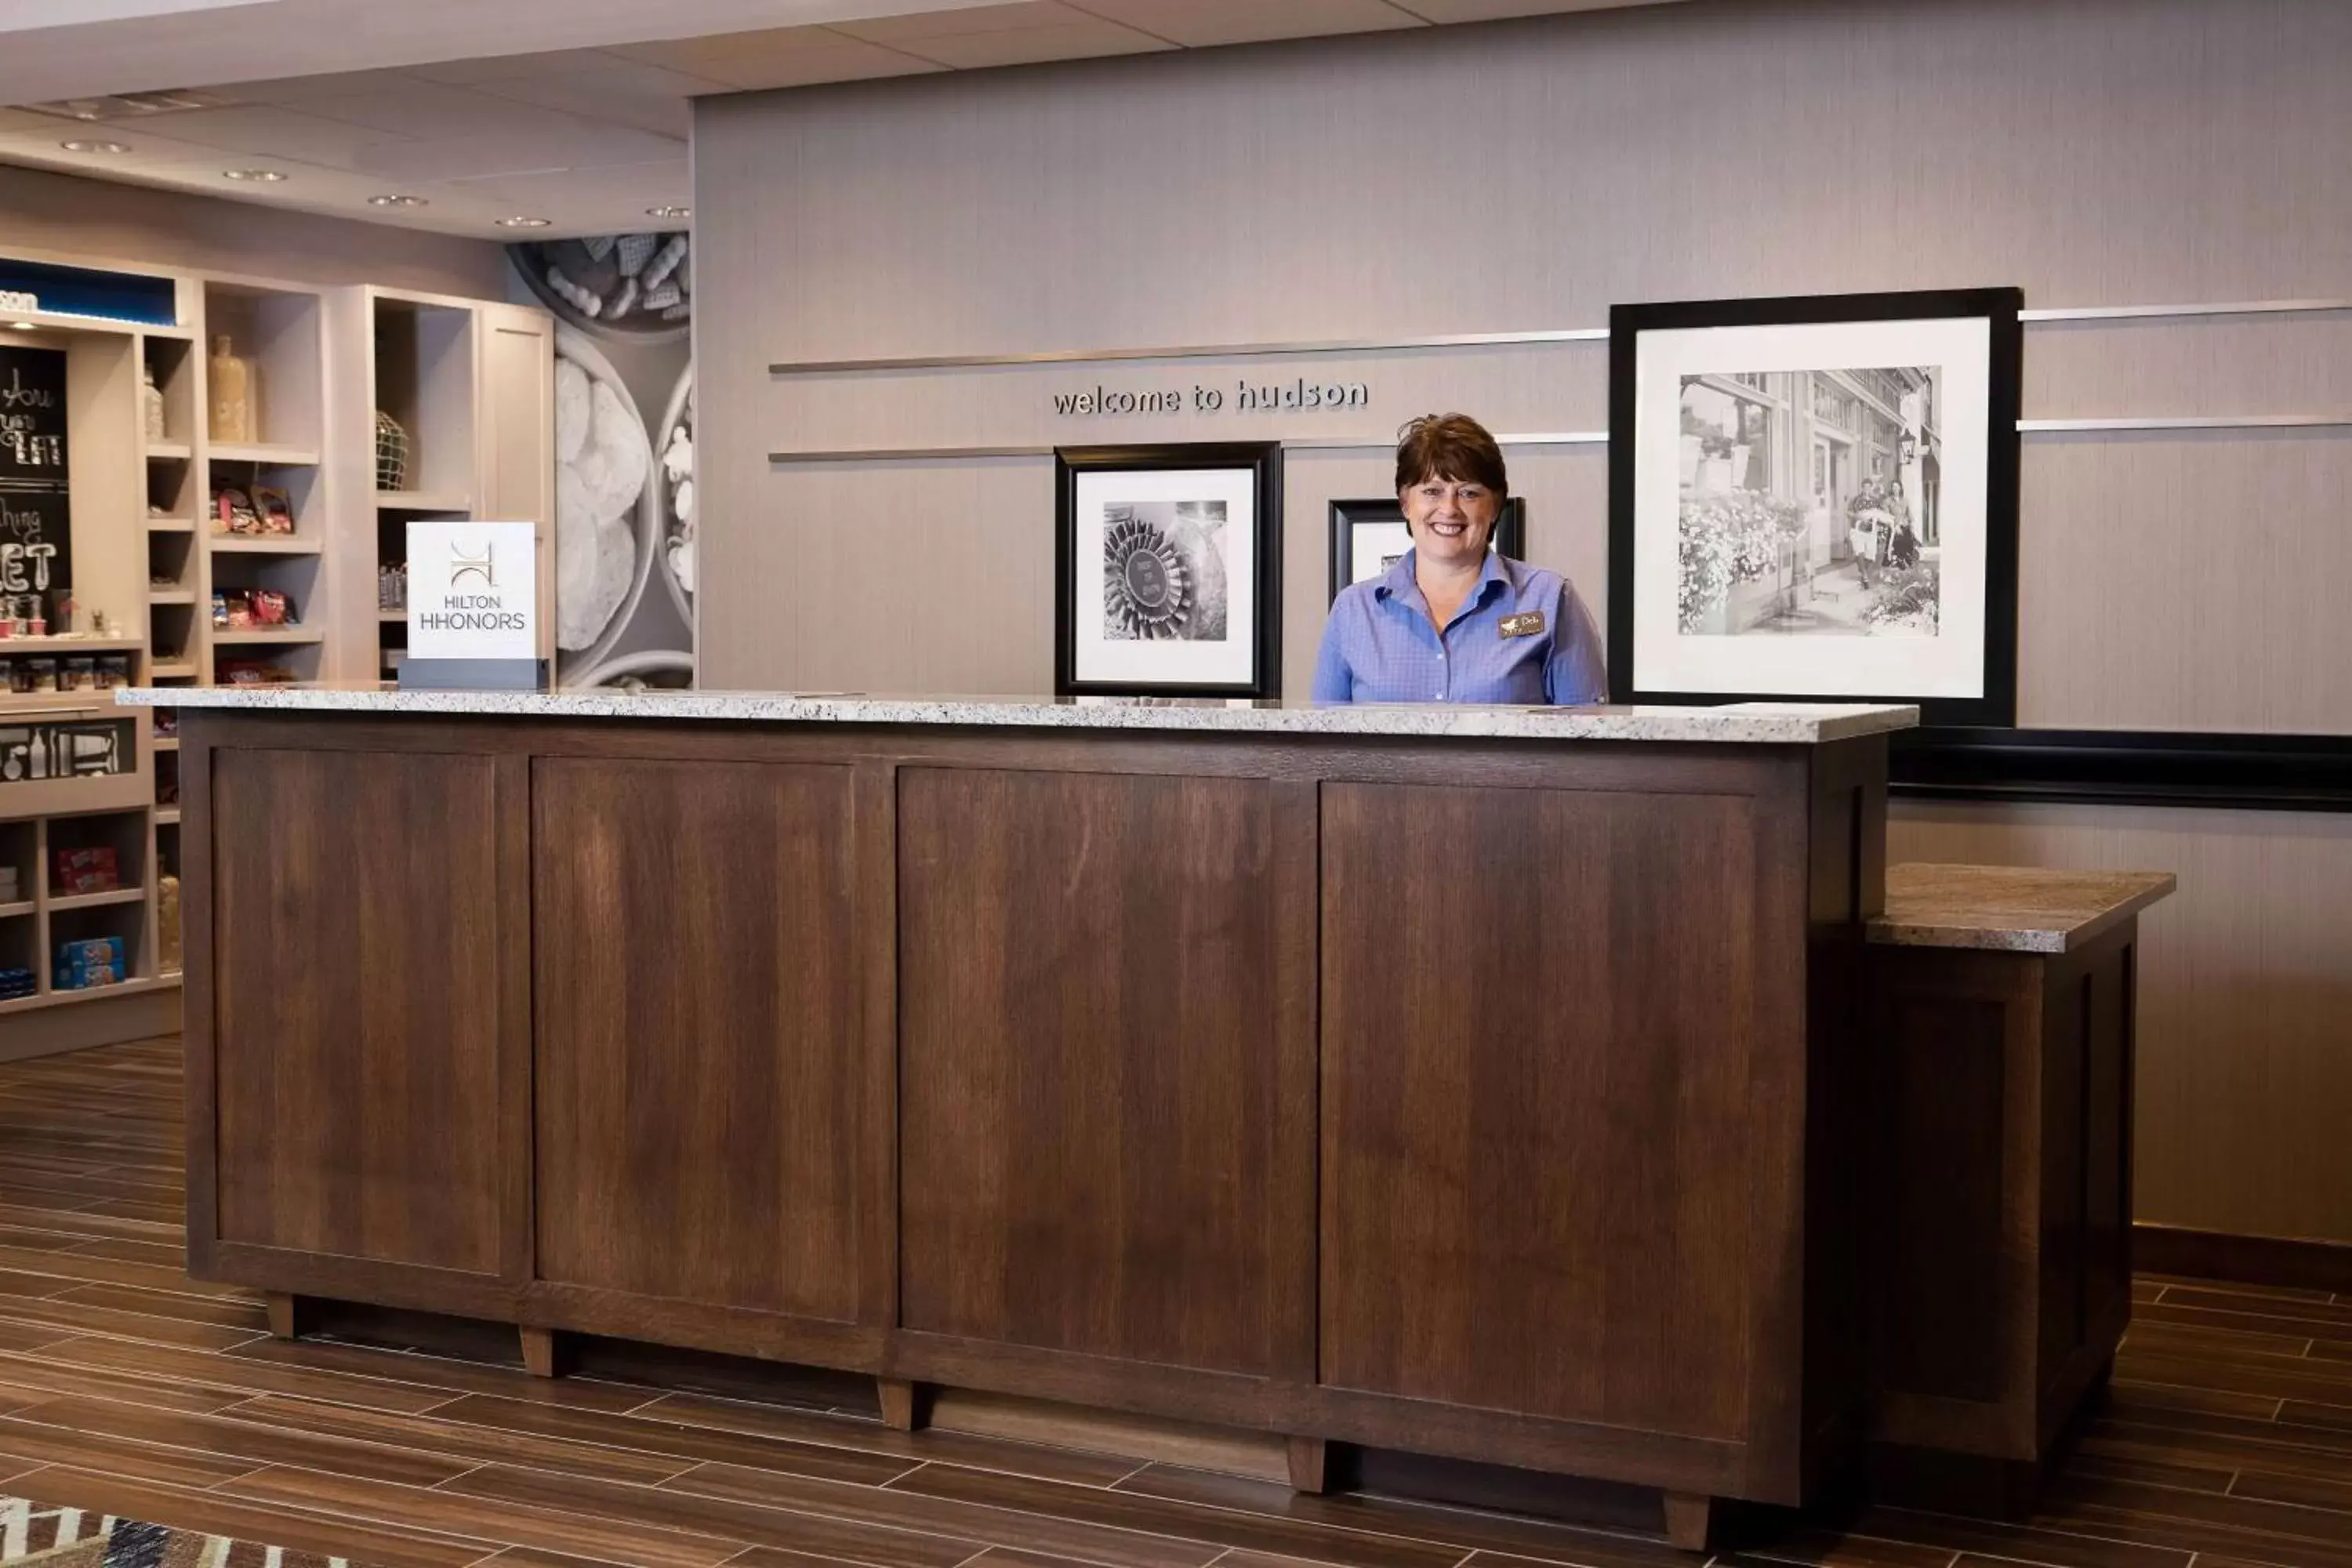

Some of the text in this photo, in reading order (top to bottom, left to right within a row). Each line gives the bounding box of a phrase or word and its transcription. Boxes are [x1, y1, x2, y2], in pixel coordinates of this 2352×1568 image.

[1054, 378, 1369, 415] welcome to hudson
[444, 595, 502, 609] HILTON
[420, 612, 526, 630] HHONORS
